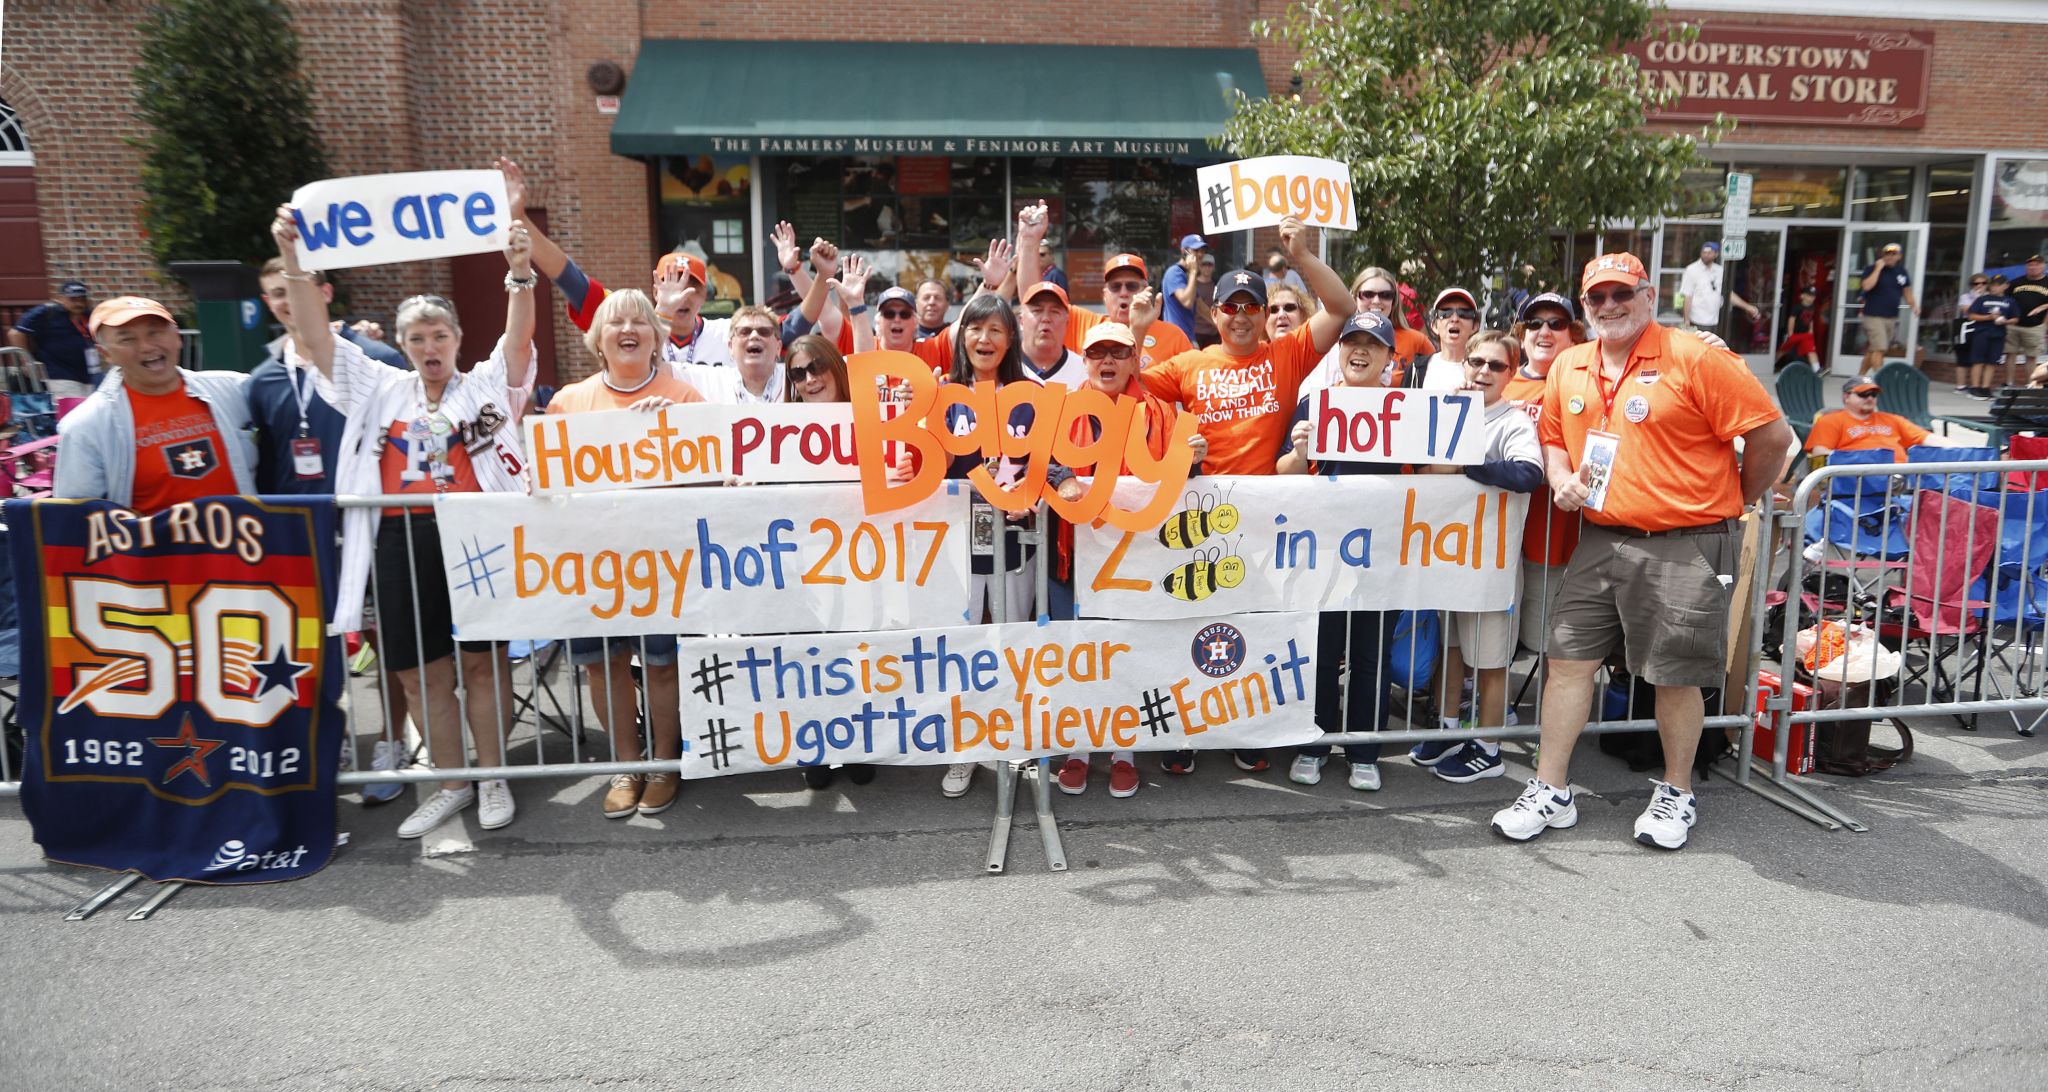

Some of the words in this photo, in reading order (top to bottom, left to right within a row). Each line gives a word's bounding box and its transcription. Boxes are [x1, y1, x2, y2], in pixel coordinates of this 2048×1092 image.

[1647, 41, 1871, 70] COOPERSTOWN
[1611, 69, 1777, 100] ENERAL
[1789, 75, 1898, 105] STORE
[711, 137, 750, 151] THE
[760, 138, 848, 151] FARMERS'
[854, 138, 933, 151] MUSEUM
[944, 139, 955, 151] &
[966, 138, 1061, 152] FENIMORE
[1069, 140, 1104, 153] ART
[1113, 140, 1190, 154] MUSEUM
[1205, 164, 1350, 227] #baggy
[291, 201, 374, 251] we
[393, 192, 497, 239] are
[242, 301, 257, 324] P
[1196, 374, 1277, 400] BASEBALL
[1208, 359, 1273, 385] WATCH
[1196, 411, 1233, 424] KNOW
[1236, 401, 1280, 418] THINGS
[1220, 398, 1247, 409] AND
[1316, 388, 1406, 457] hof
[1427, 394, 1472, 460] 17
[533, 409, 722, 489] Houston
[847, 350, 1199, 532] Baggy
[496, 444, 521, 476] 5
[84, 501, 264, 565] ASTROS
[1275, 513, 1317, 569] in
[1339, 528, 1372, 568] a
[1400, 488, 1508, 569] hall
[1198, 625, 1239, 642] HOUSTON
[64, 573, 298, 728] 50
[1200, 660, 1238, 675] ASTROS
[65, 739, 143, 766] 1962
[229, 746, 300, 778] 2012
[236, 845, 308, 872] at&t
